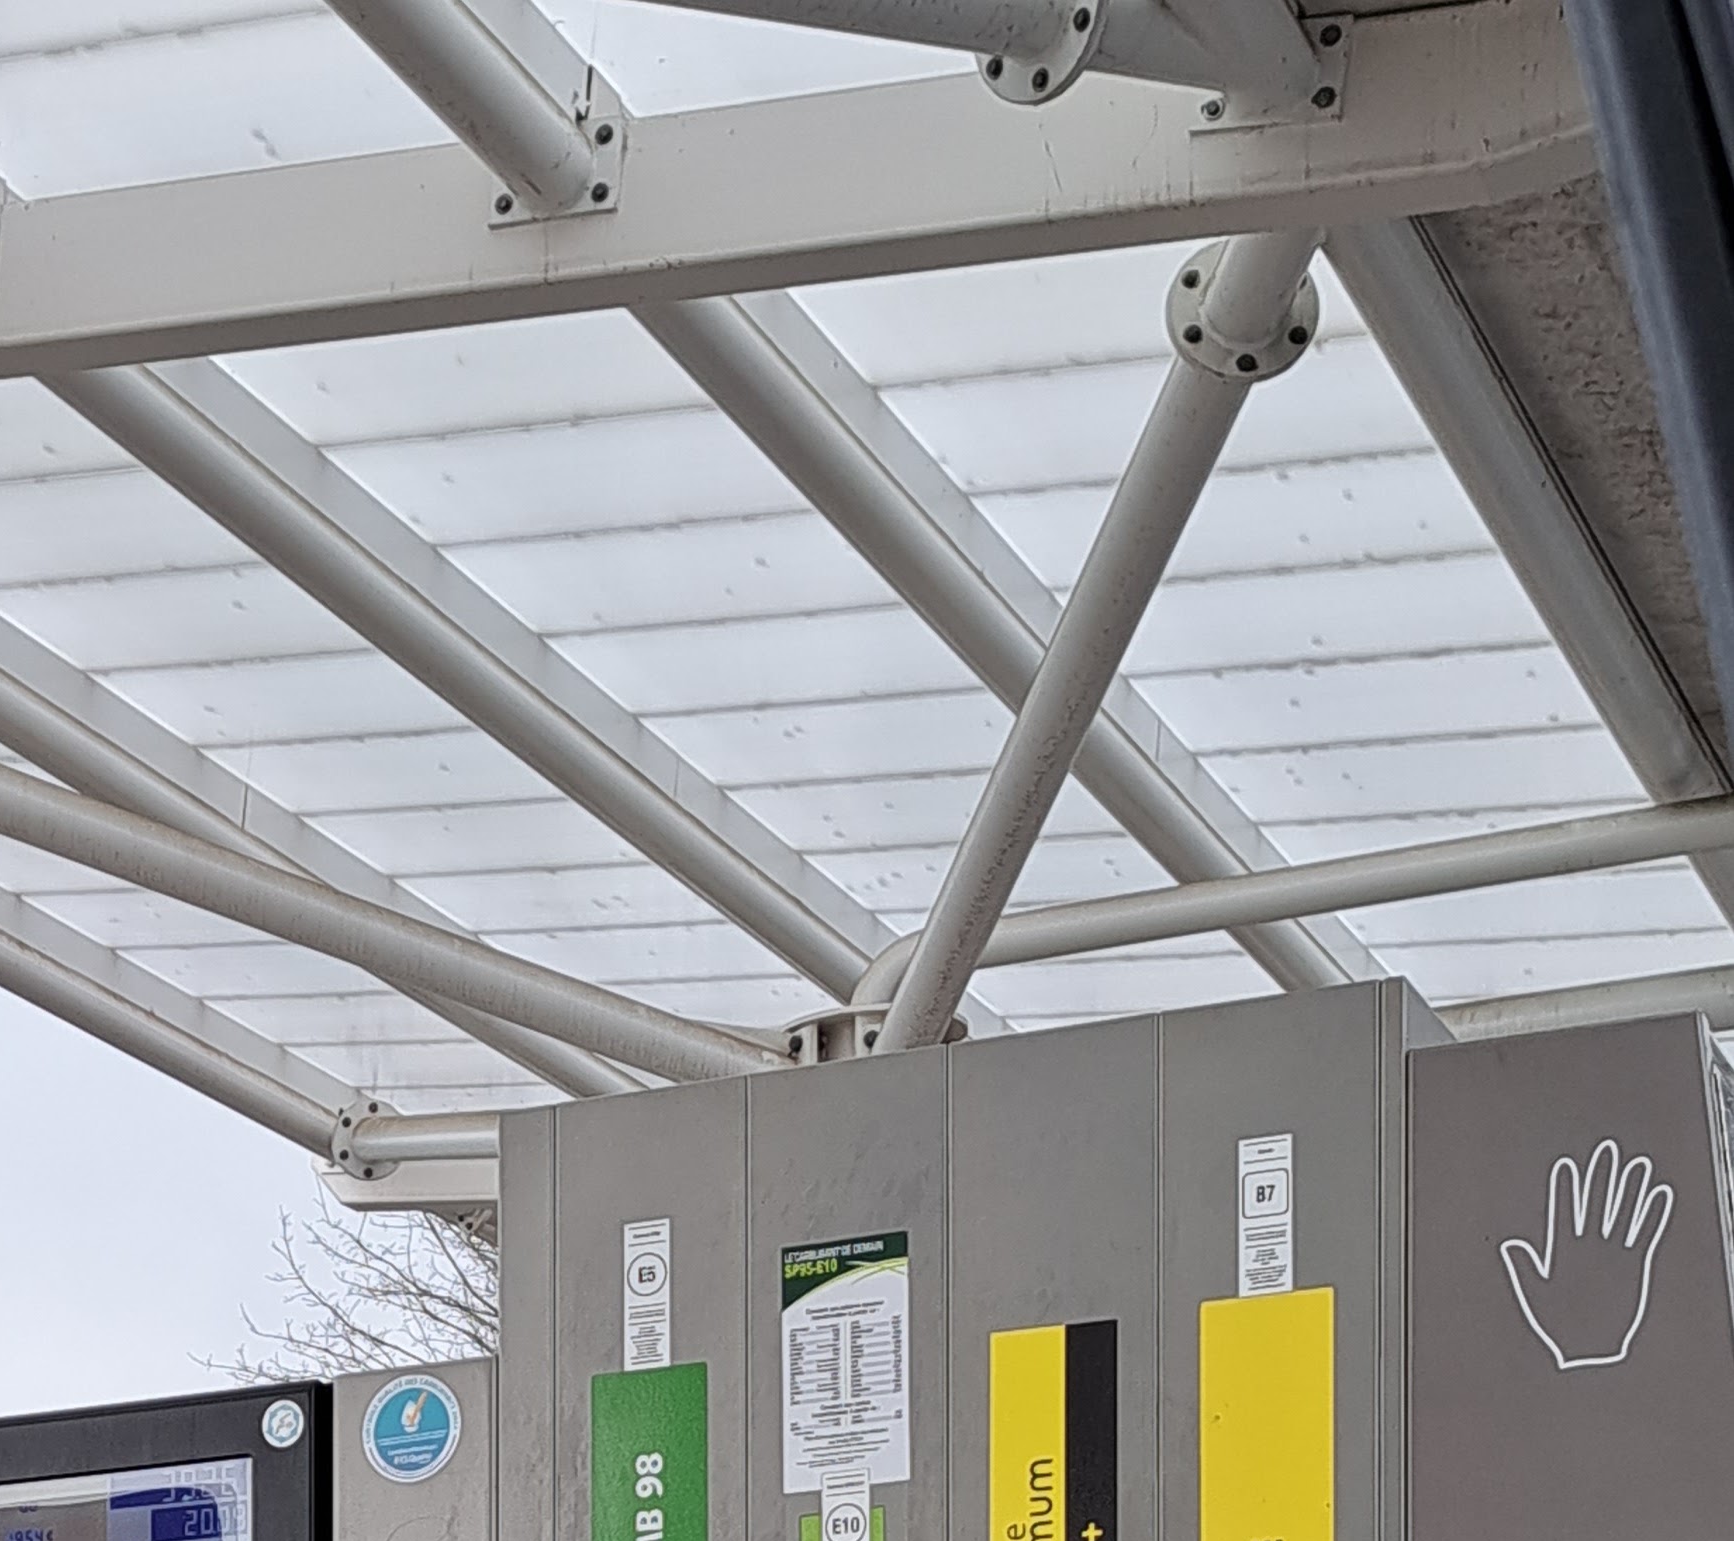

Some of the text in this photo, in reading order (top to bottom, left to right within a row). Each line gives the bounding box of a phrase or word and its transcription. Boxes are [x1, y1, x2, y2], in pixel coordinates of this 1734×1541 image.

[1255, 1184, 1276, 1204] B7
[784, 1258, 838, 1279] SP95-E10
[635, 1452, 664, 1499] 98
[832, 1516, 860, 1535] E10
